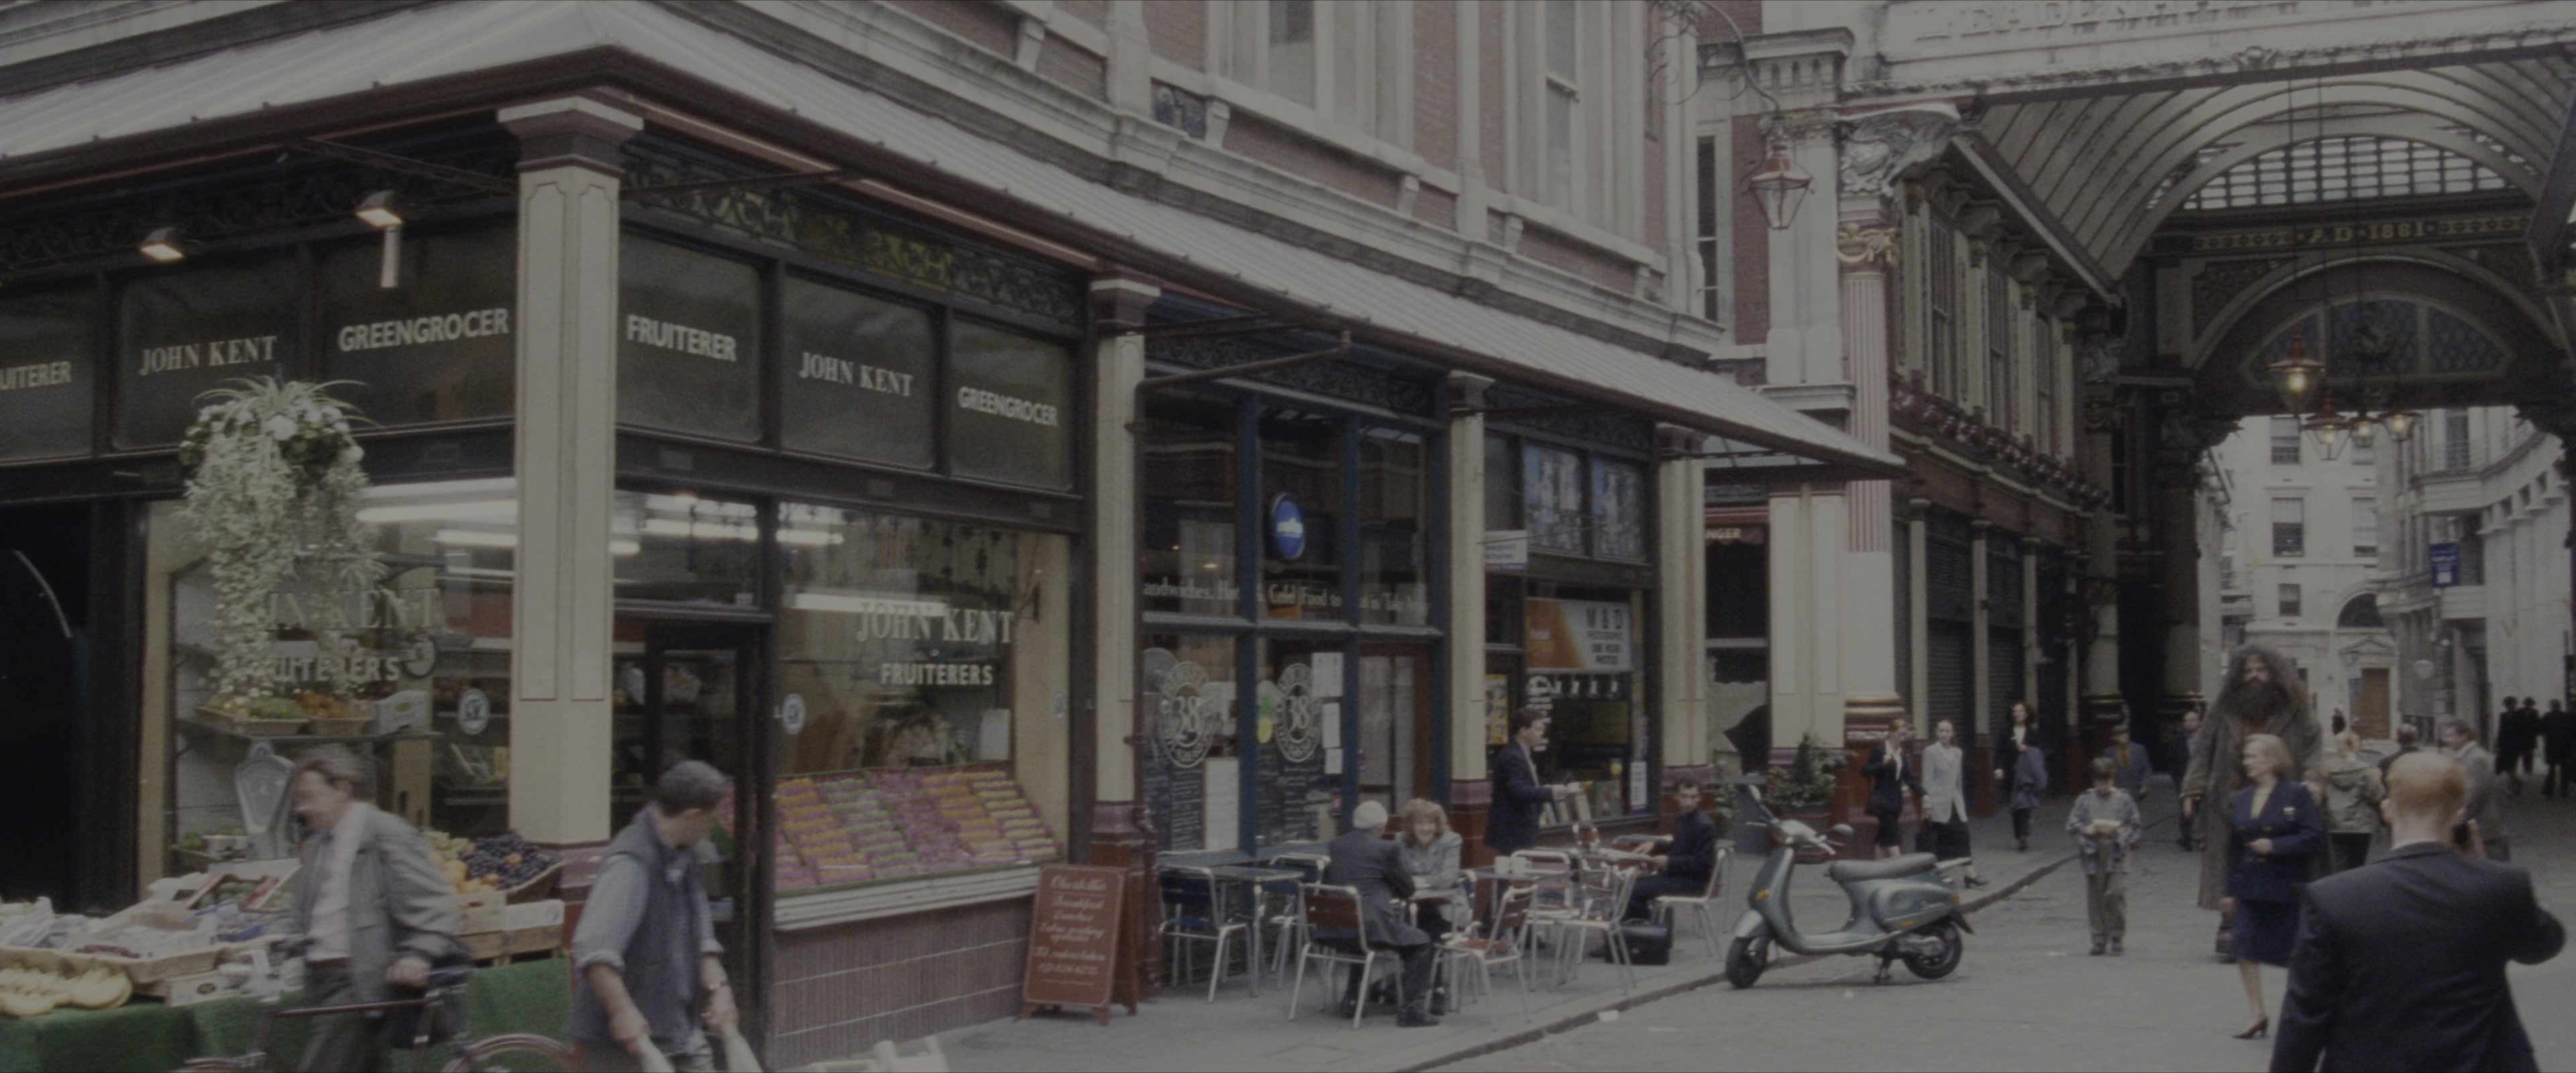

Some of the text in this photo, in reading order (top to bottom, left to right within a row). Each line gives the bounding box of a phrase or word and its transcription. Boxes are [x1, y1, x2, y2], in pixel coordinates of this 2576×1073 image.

[338, 307, 509, 353] GREENGROCER
[627, 315, 737, 363] FRUITERER
[138, 336, 277, 376] JOHN KENT
[800, 352, 913, 397] JOHN KENT
[958, 386, 1059, 427] GREENGROCER
[1267, 583, 1295, 604] Cold
[1301, 585, 1328, 606] Food
[856, 602, 1014, 645] JOHN KENT
[879, 663, 994, 686] FRUITERERS
[1172, 695, 1201, 736] 38
[1285, 695, 1310, 733] 38
